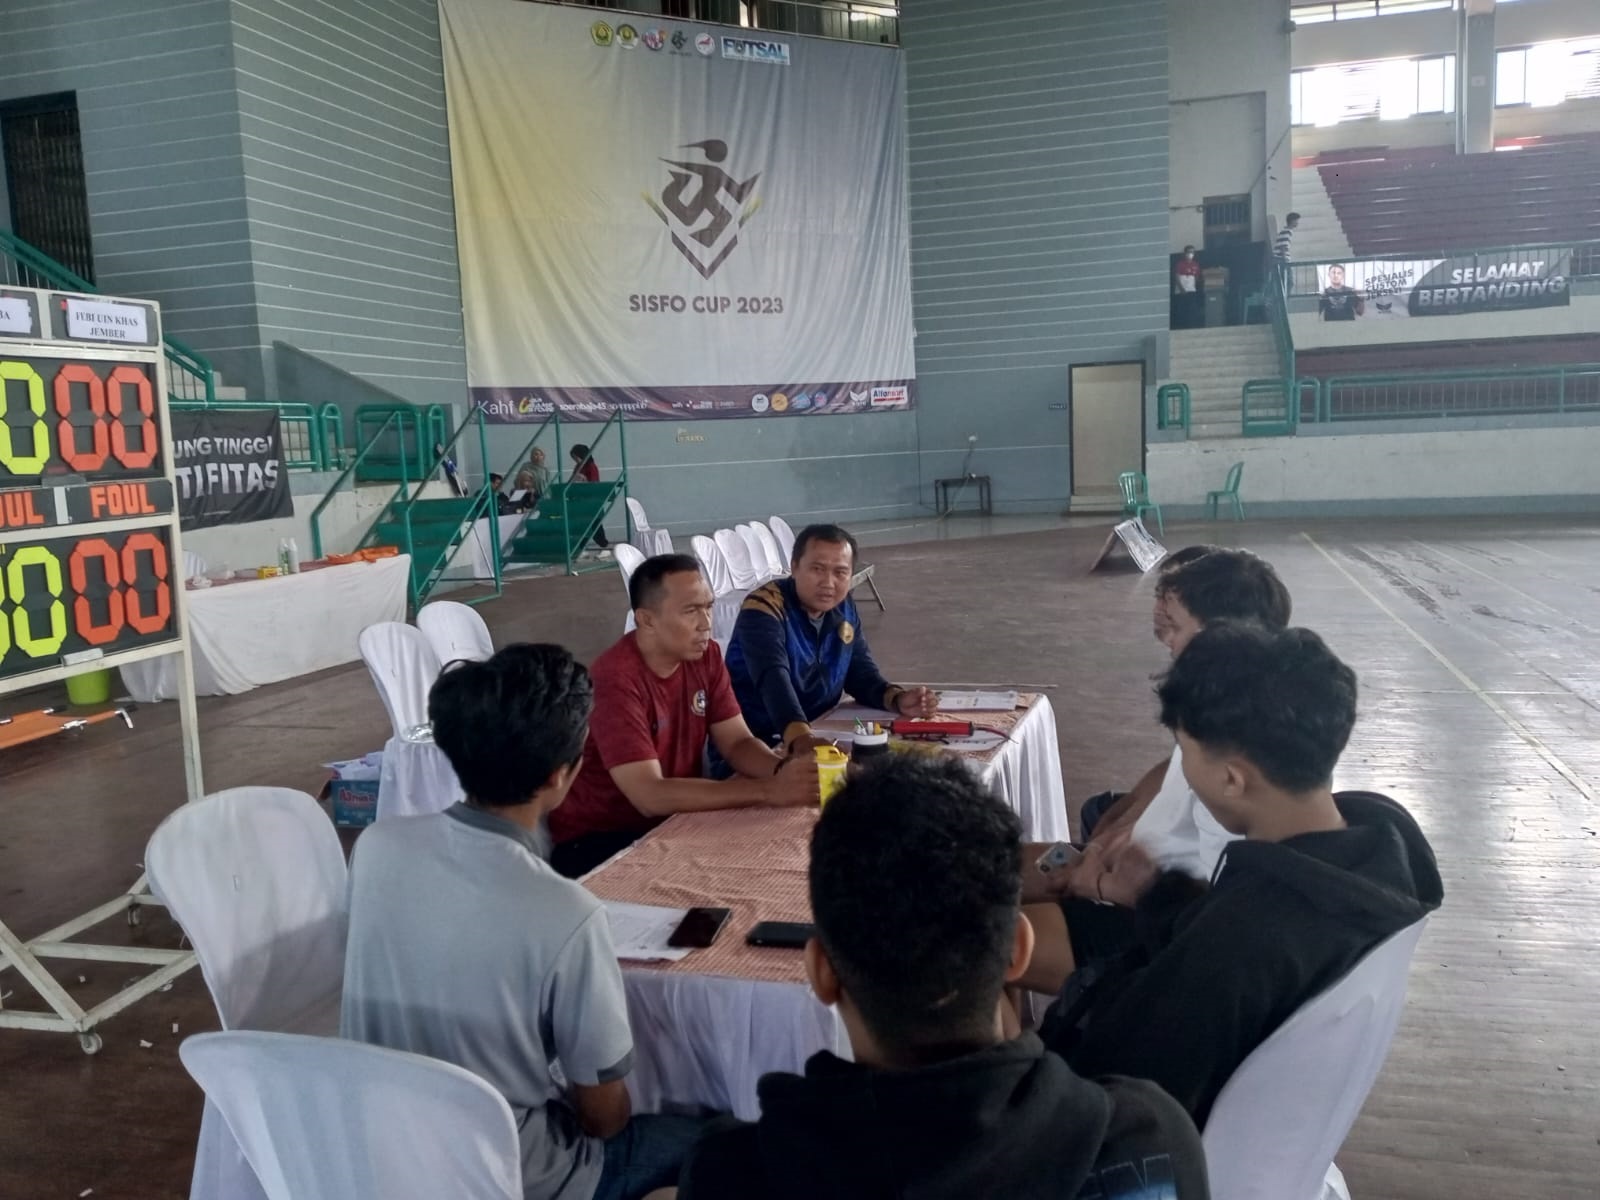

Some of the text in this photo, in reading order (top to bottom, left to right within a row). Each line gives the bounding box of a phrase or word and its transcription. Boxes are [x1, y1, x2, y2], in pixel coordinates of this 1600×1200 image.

[1451, 261, 1544, 285] SELAMAT
[1418, 276, 1565, 307] BERTANDING
[629, 294, 784, 314] SISFO CUP 2023
[90, 327, 126, 338] JEMBER
[115, 316, 139, 327] KHAS
[54, 363, 157, 471] 00
[477, 399, 514, 415] Kahf
[90, 484, 156, 518] FOUL
[69, 532, 171, 646] 00
